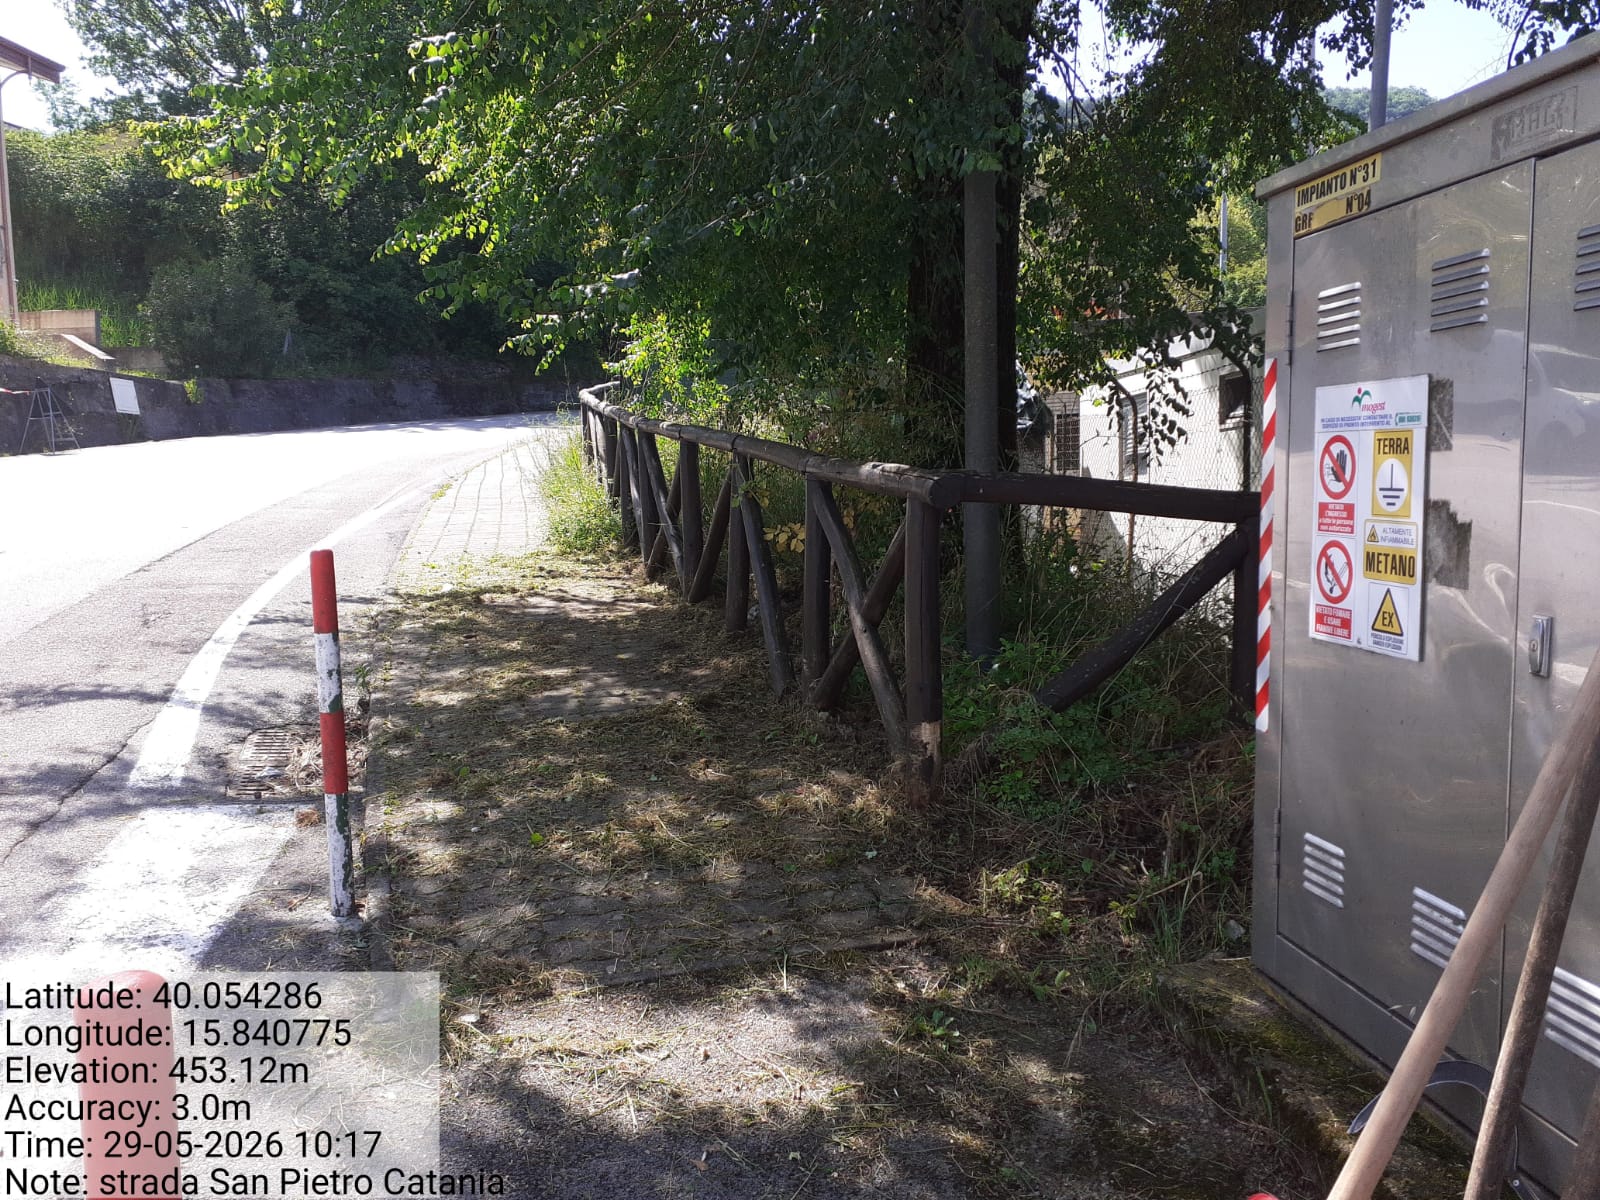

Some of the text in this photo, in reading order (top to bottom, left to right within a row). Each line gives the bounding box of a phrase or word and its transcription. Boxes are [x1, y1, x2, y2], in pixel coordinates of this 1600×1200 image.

[1297, 158, 1377, 207] IMPIANTO N°31
[1345, 189, 1372, 215] N°04
[1376, 437, 1410, 455] TERRA
[1382, 527, 1413, 537] ALTAMENTE
[1365, 551, 1415, 578] METANO
[1381, 611, 1394, 628] EX
